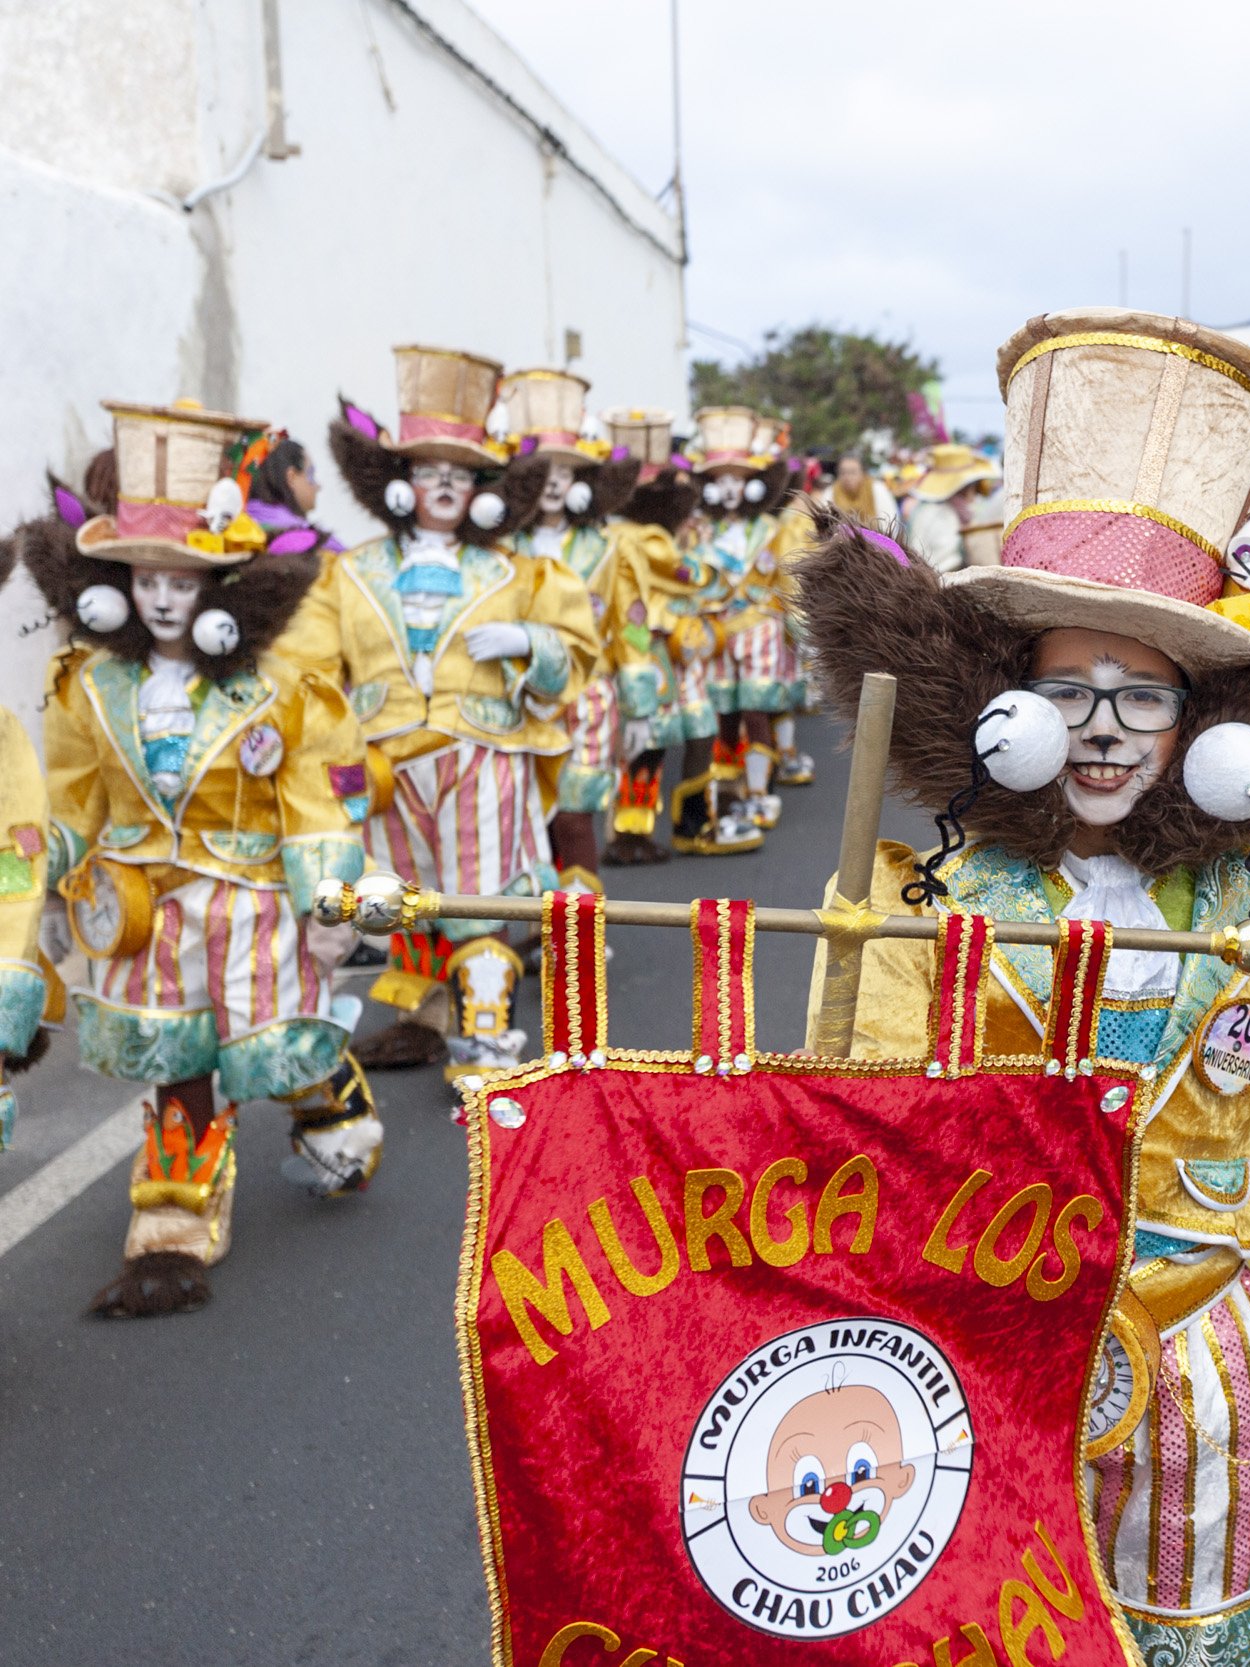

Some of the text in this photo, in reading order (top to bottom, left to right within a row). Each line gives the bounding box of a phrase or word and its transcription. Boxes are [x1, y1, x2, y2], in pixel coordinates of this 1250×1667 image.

[491, 1154, 1103, 1366] MURGA LOS
[700, 1328, 952, 1450] MURGA INFANTIL
[731, 1529, 935, 1629] CHAU CHAU
[815, 1557, 861, 1582] 2006
